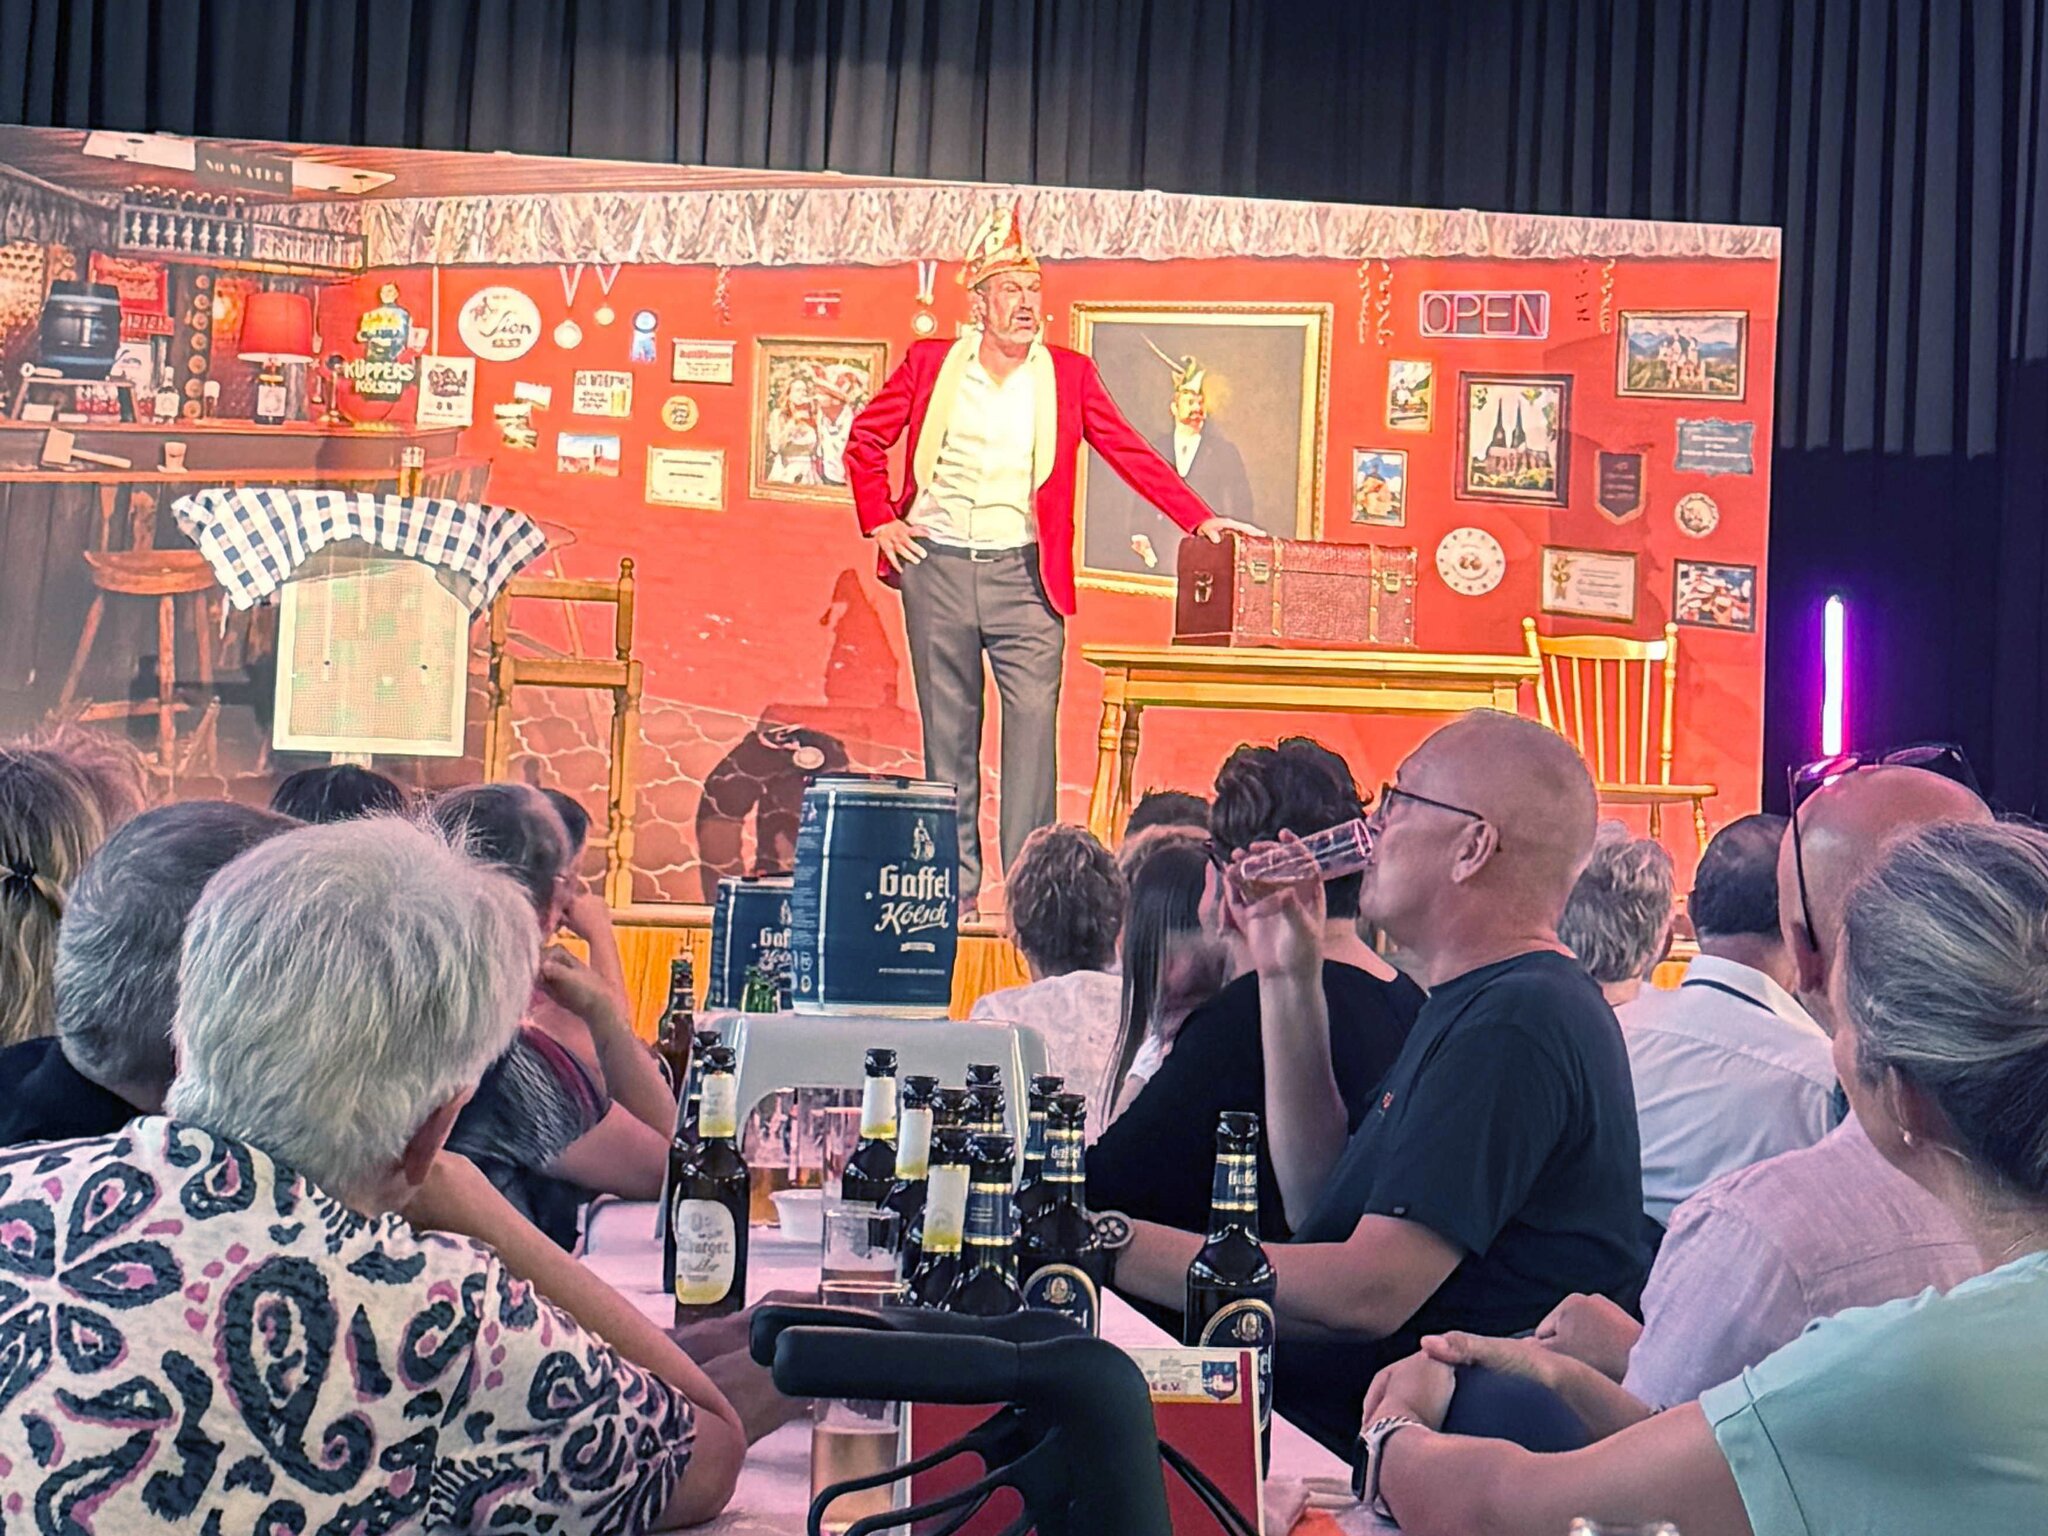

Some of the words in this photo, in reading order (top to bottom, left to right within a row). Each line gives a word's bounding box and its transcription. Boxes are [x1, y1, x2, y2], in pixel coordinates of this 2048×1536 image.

[1424, 294, 1544, 335] OPEN
[343, 358, 415, 382] KÜPPERS
[879, 863, 951, 901] Gaffel
[874, 901, 949, 936] Kölsch
[760, 927, 792, 949] Gaf
